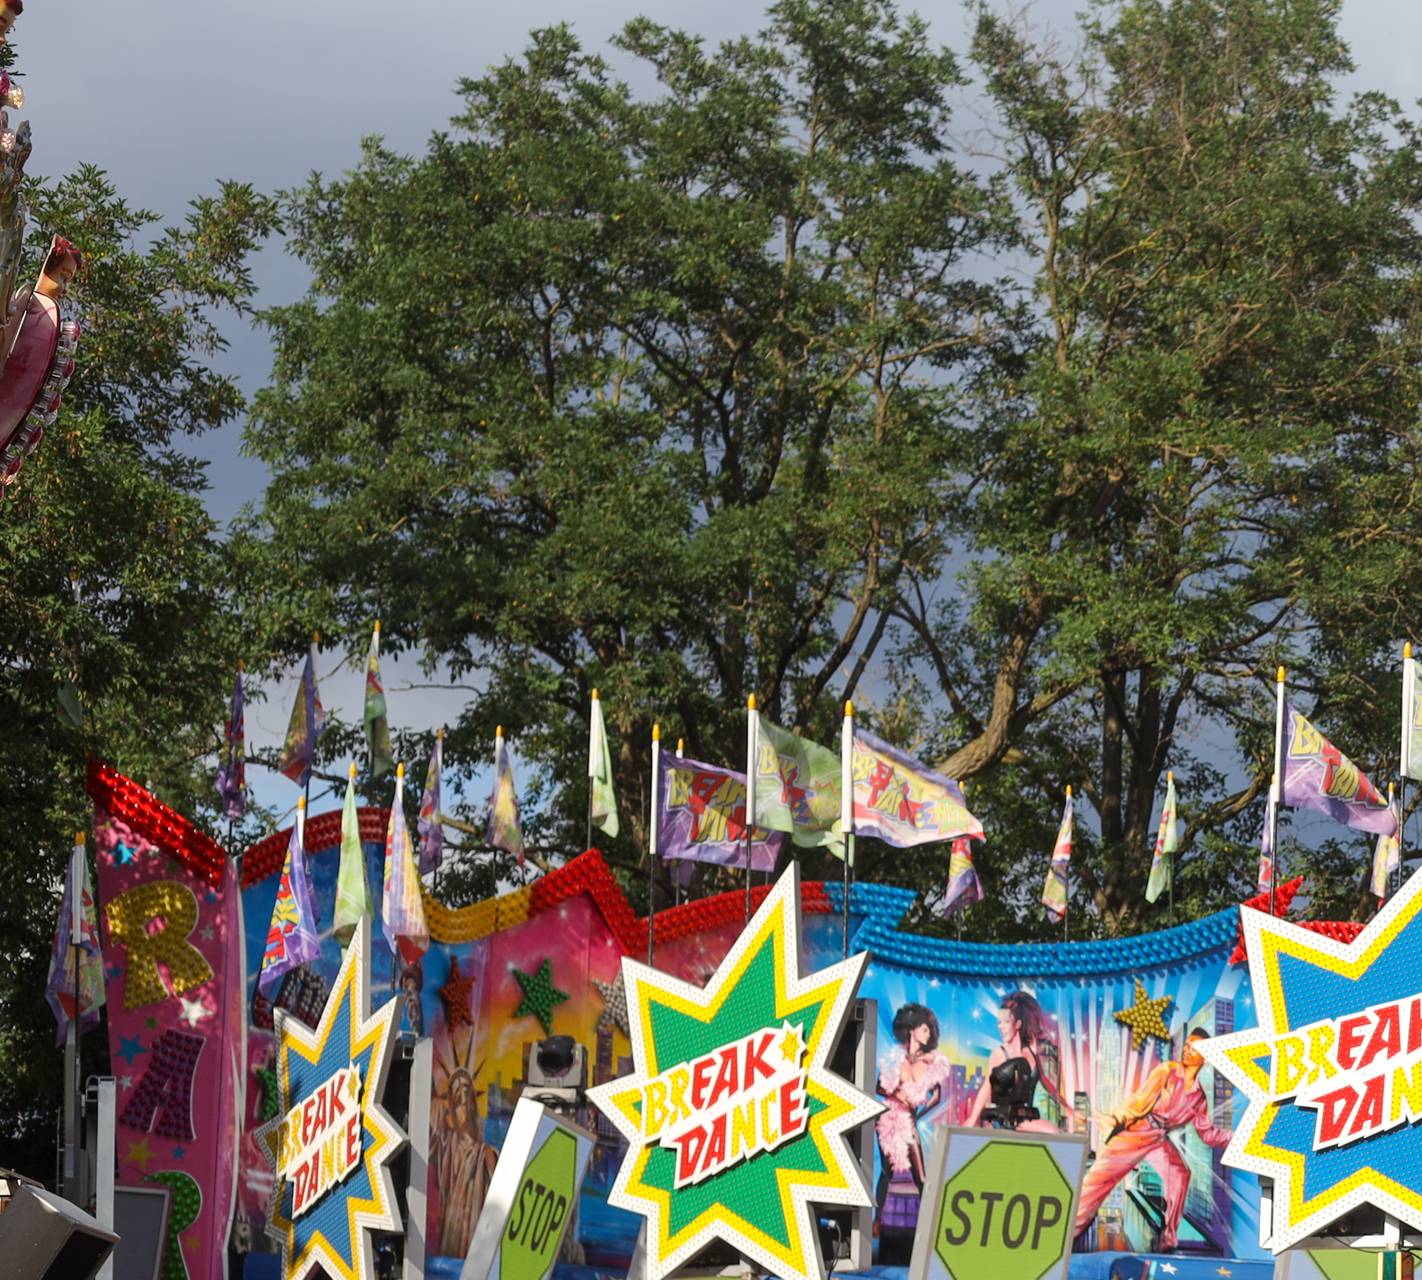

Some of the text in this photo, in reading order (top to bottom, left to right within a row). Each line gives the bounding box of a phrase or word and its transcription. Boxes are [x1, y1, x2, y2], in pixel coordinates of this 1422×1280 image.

[278, 1074, 347, 1170] BREAK
[642, 1032, 777, 1135] BREAK
[674, 1076, 803, 1182] DANCE
[293, 1111, 358, 1215] DANCE
[507, 1179, 567, 1253] STOP
[944, 1190, 1063, 1252] STOP
